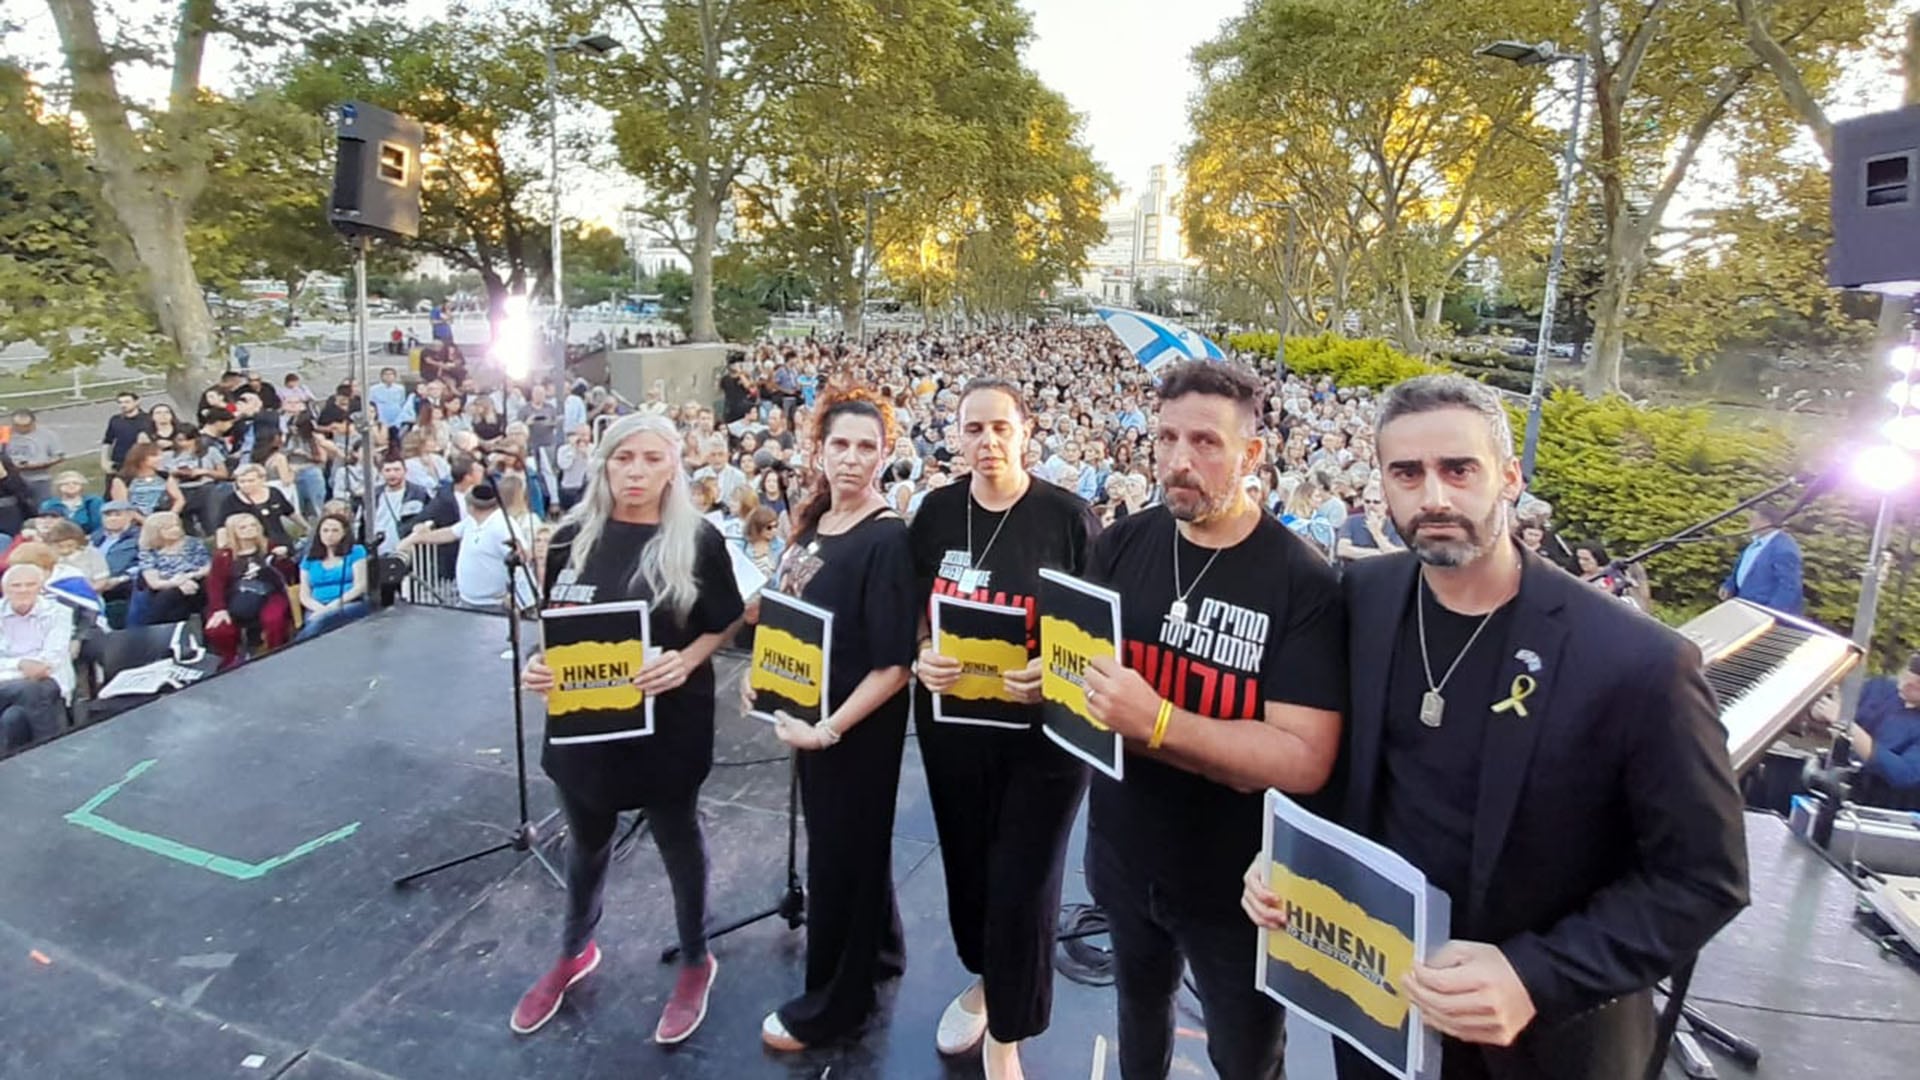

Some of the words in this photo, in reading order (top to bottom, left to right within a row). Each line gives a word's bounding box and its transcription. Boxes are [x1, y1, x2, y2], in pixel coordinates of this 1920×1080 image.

[1197, 597, 1270, 643] מחזירים
[763, 647, 811, 678] HINENI
[1052, 643, 1092, 675] HINE
[1212, 632, 1264, 673] אותם
[562, 661, 630, 681] HINENI
[1286, 900, 1386, 976] HINENI
